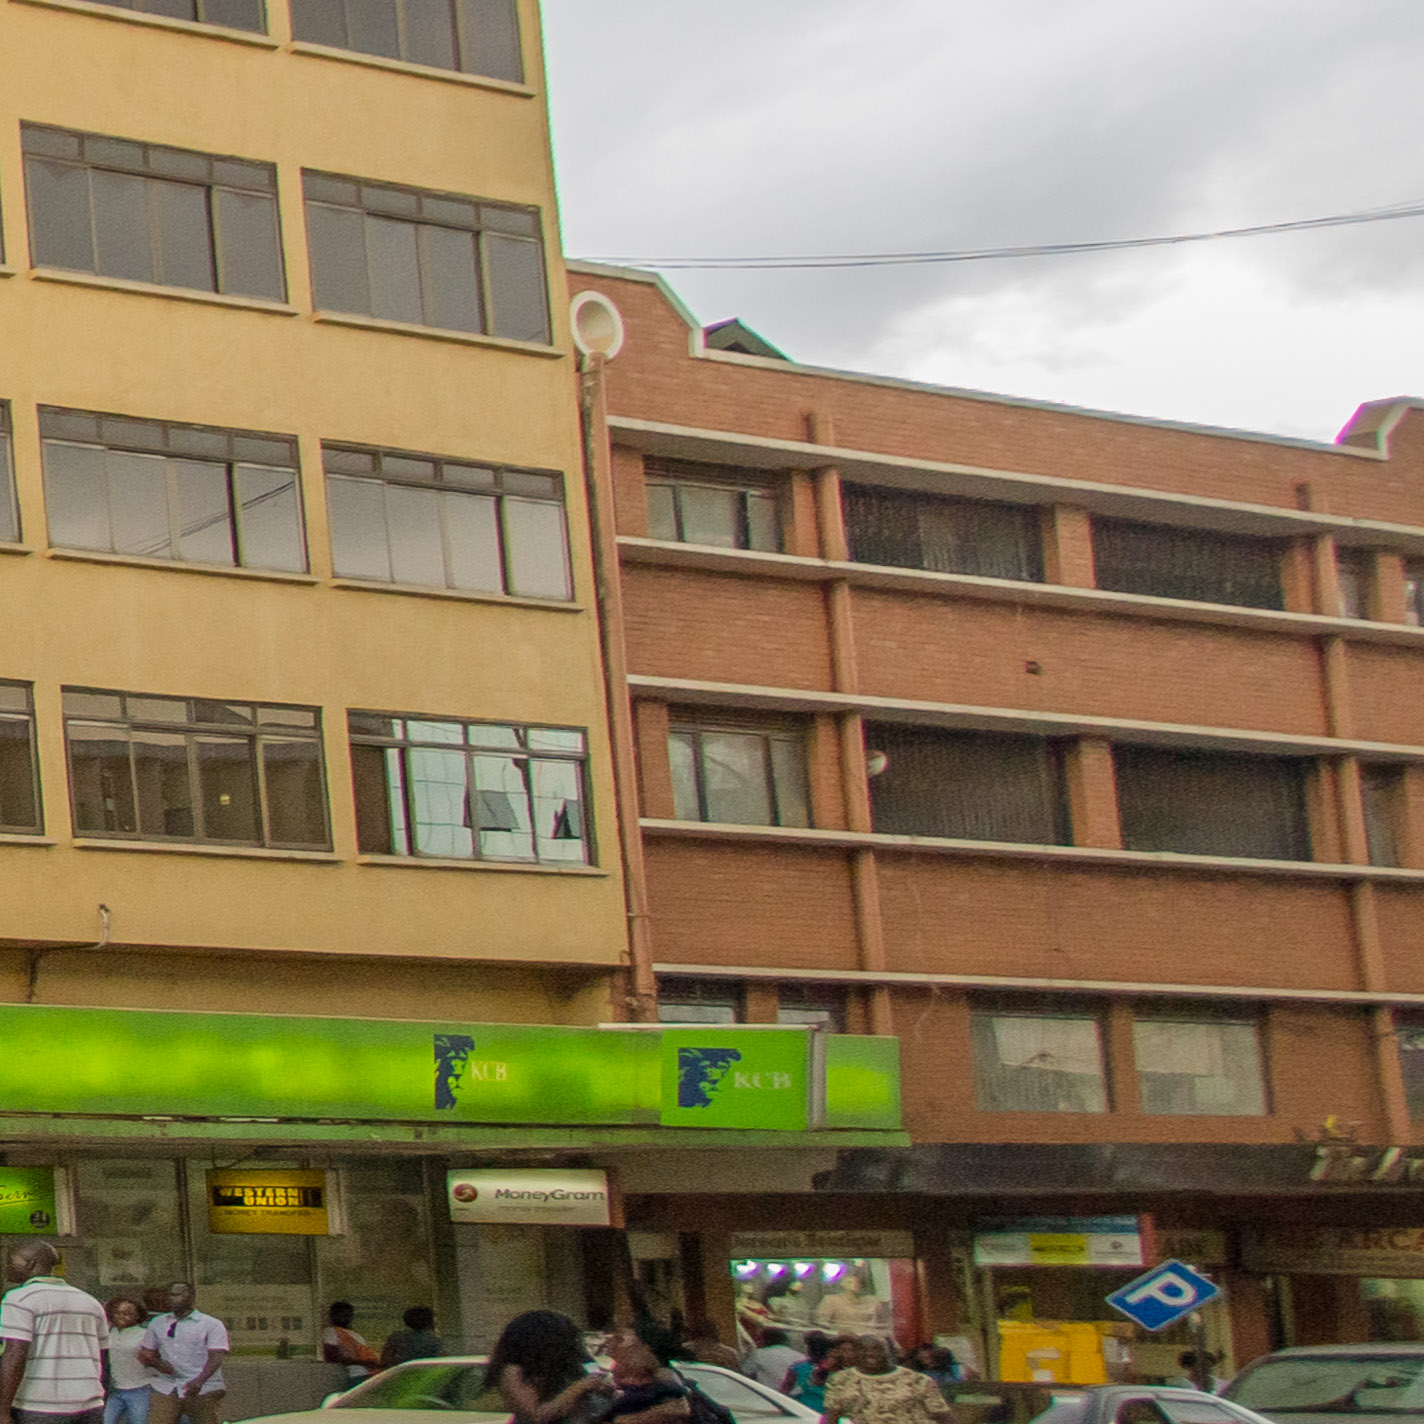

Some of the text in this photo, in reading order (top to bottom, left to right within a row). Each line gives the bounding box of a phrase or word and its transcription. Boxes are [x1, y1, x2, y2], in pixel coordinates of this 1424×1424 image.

[471, 1060, 508, 1081] KCB
[733, 1071, 792, 1090] KCB
[219, 1187, 299, 1197] WESTERN
[495, 1188, 605, 1202] MoneyGram
[243, 1196, 299, 1206] UNION
[1124, 1271, 1197, 1306] P
